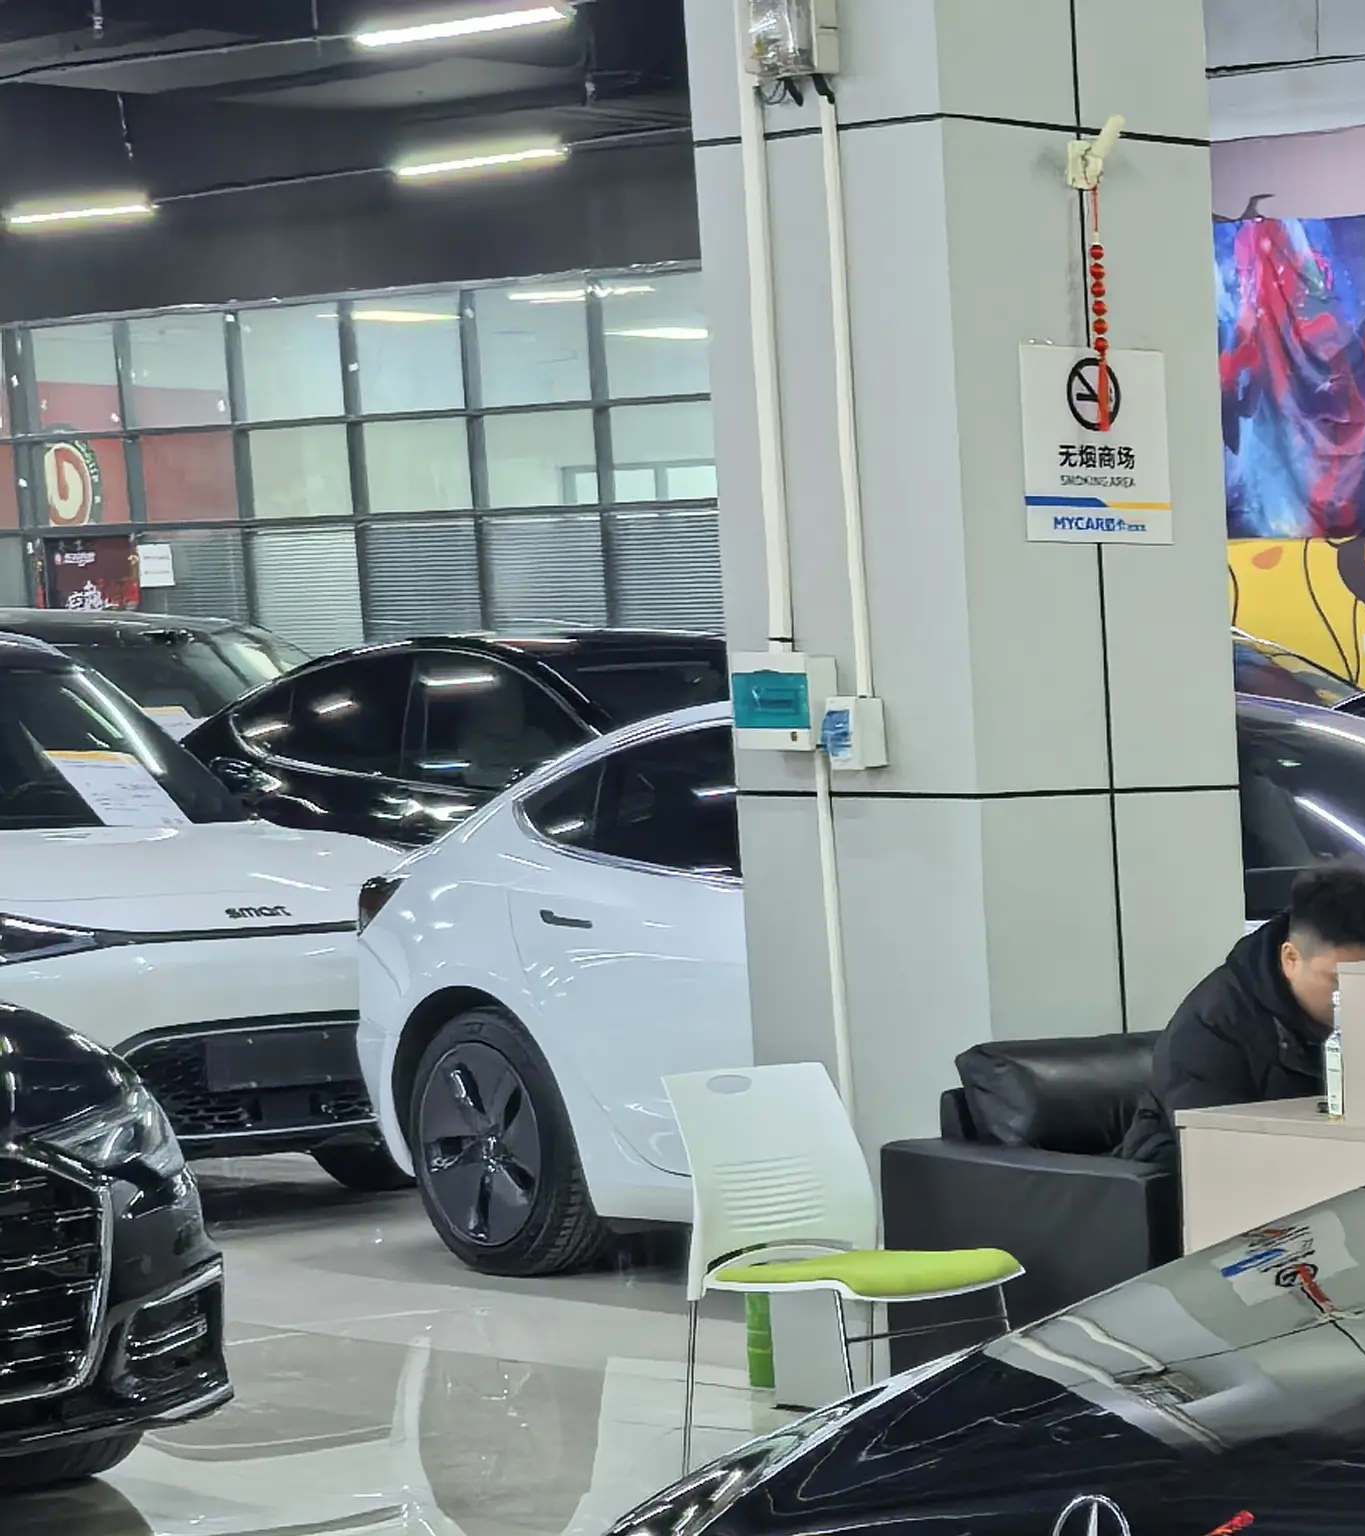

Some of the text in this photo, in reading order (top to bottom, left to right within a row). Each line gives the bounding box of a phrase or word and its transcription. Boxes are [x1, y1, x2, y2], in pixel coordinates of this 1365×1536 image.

[1058, 444, 1136, 470] 无烟商场
[225, 905, 292, 919] smart
